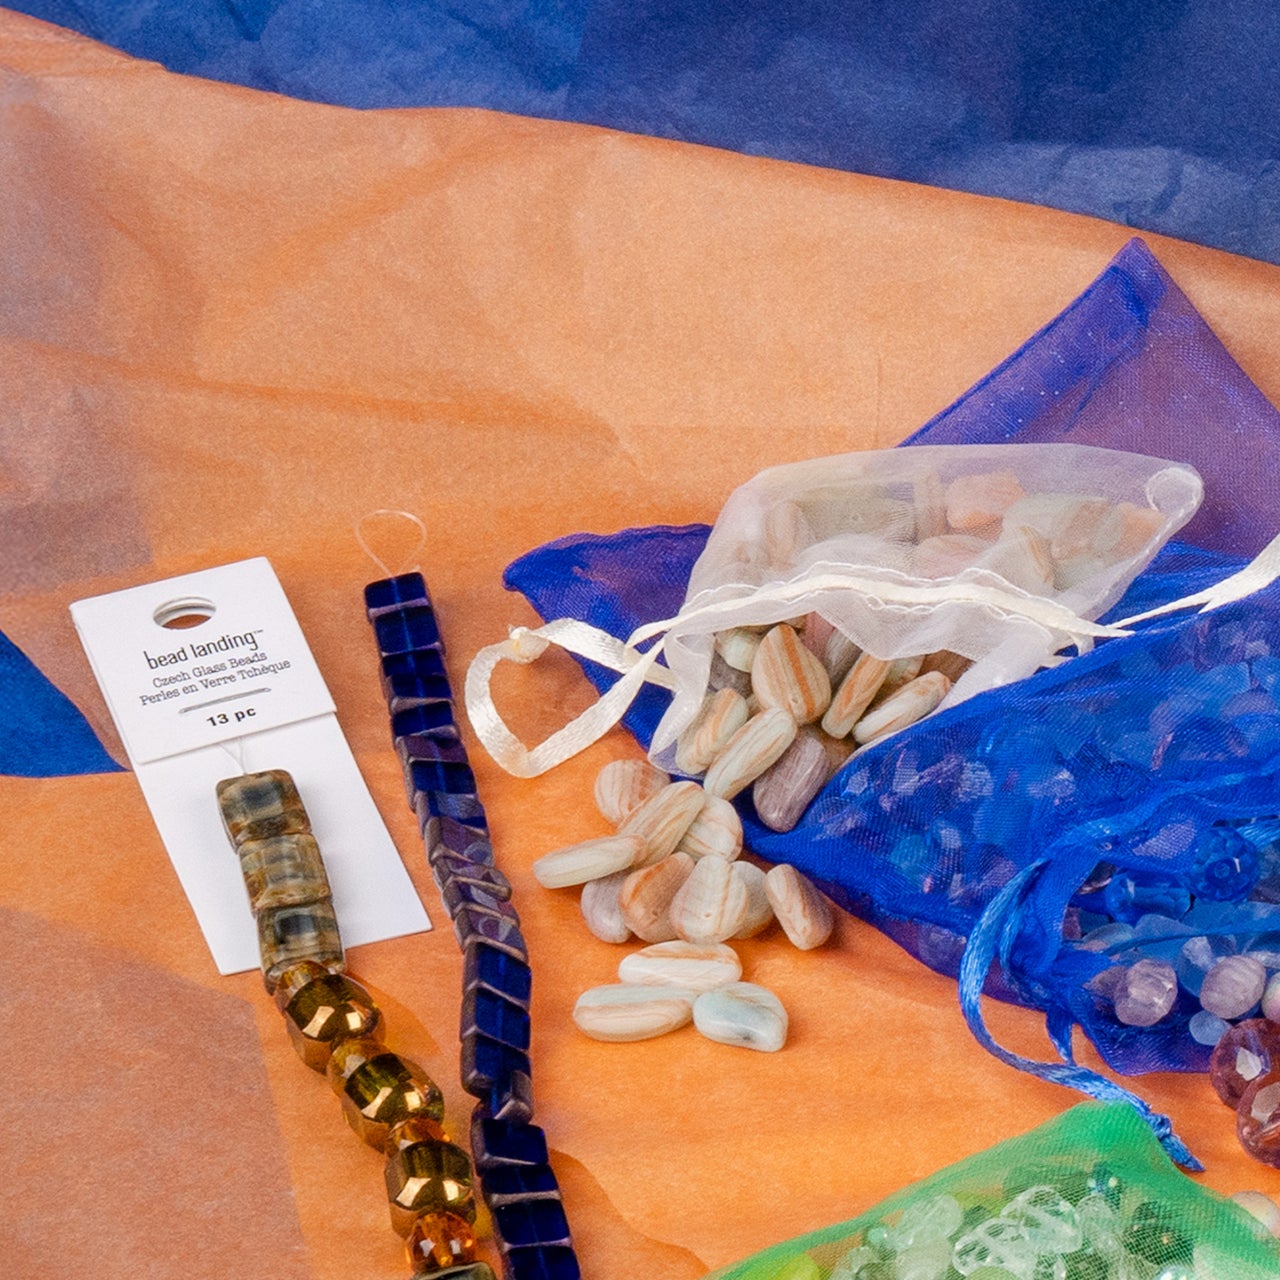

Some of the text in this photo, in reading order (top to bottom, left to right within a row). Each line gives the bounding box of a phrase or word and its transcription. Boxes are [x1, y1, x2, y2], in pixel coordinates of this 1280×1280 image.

[143, 650, 188, 670] bead
[152, 650, 268, 688] Czech Glass Beads
[139, 690, 181, 706] Perles
[182, 683, 199, 695] en
[199, 671, 237, 689] Verre
[206, 707, 257, 727] 13 pc
